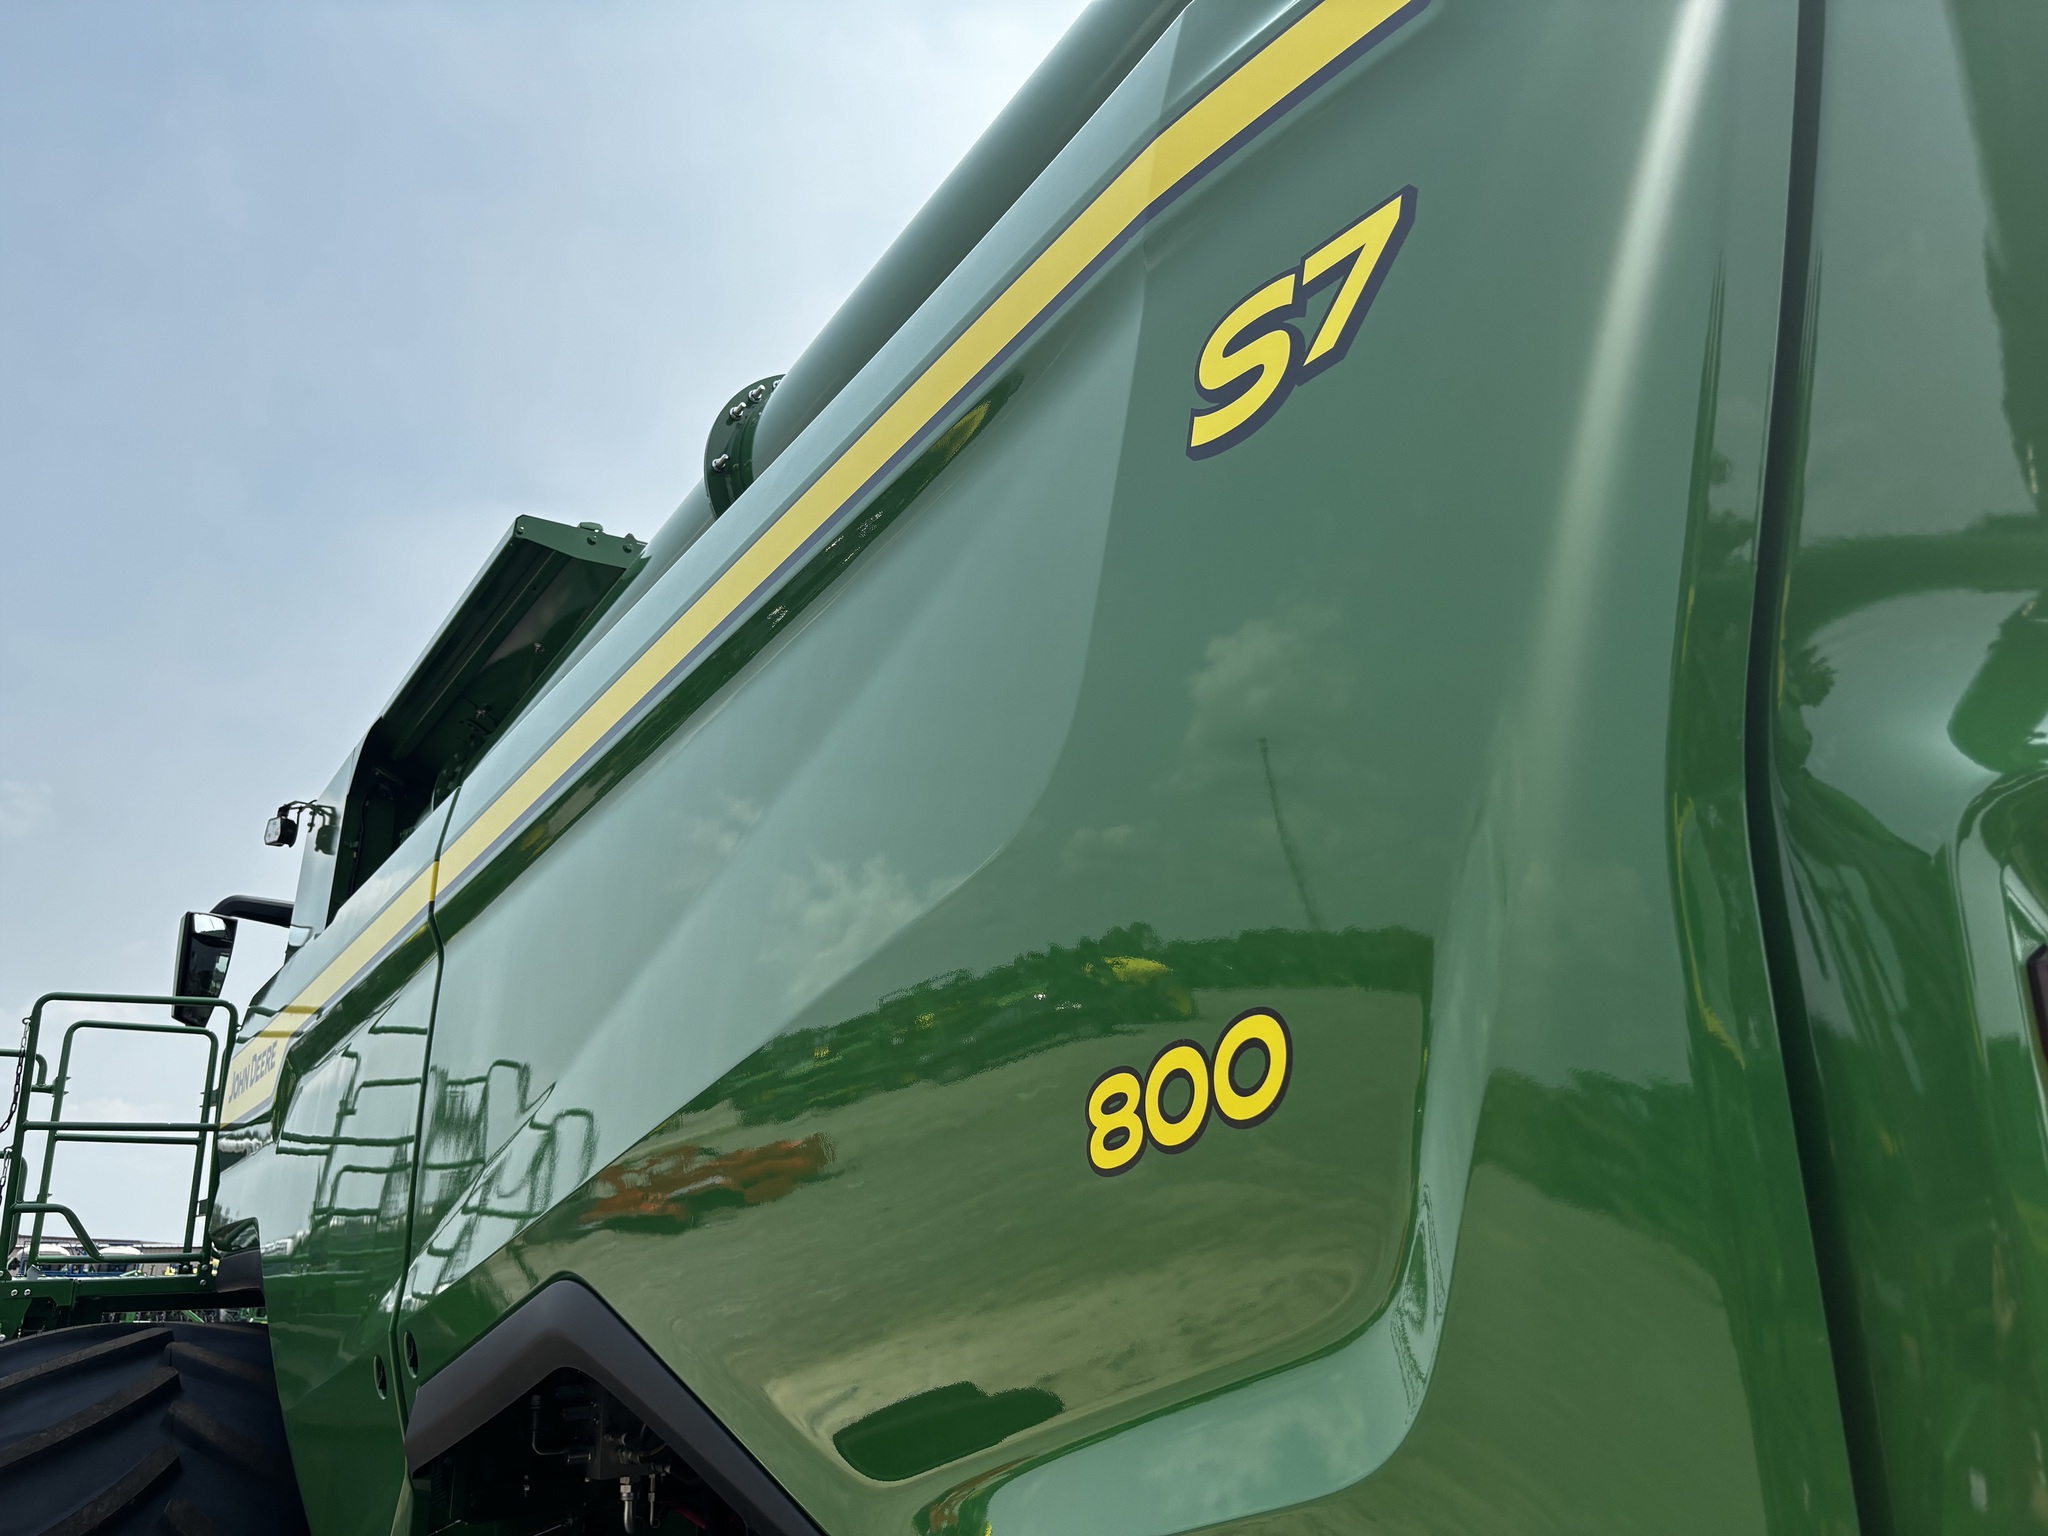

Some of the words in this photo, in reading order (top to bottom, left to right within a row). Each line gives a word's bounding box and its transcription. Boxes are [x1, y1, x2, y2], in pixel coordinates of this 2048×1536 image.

[1188, 186, 1416, 459] S7
[228, 1063, 251, 1104] JOHN
[249, 1040, 278, 1087] DEERE
[1086, 1008, 1292, 1176] 800
